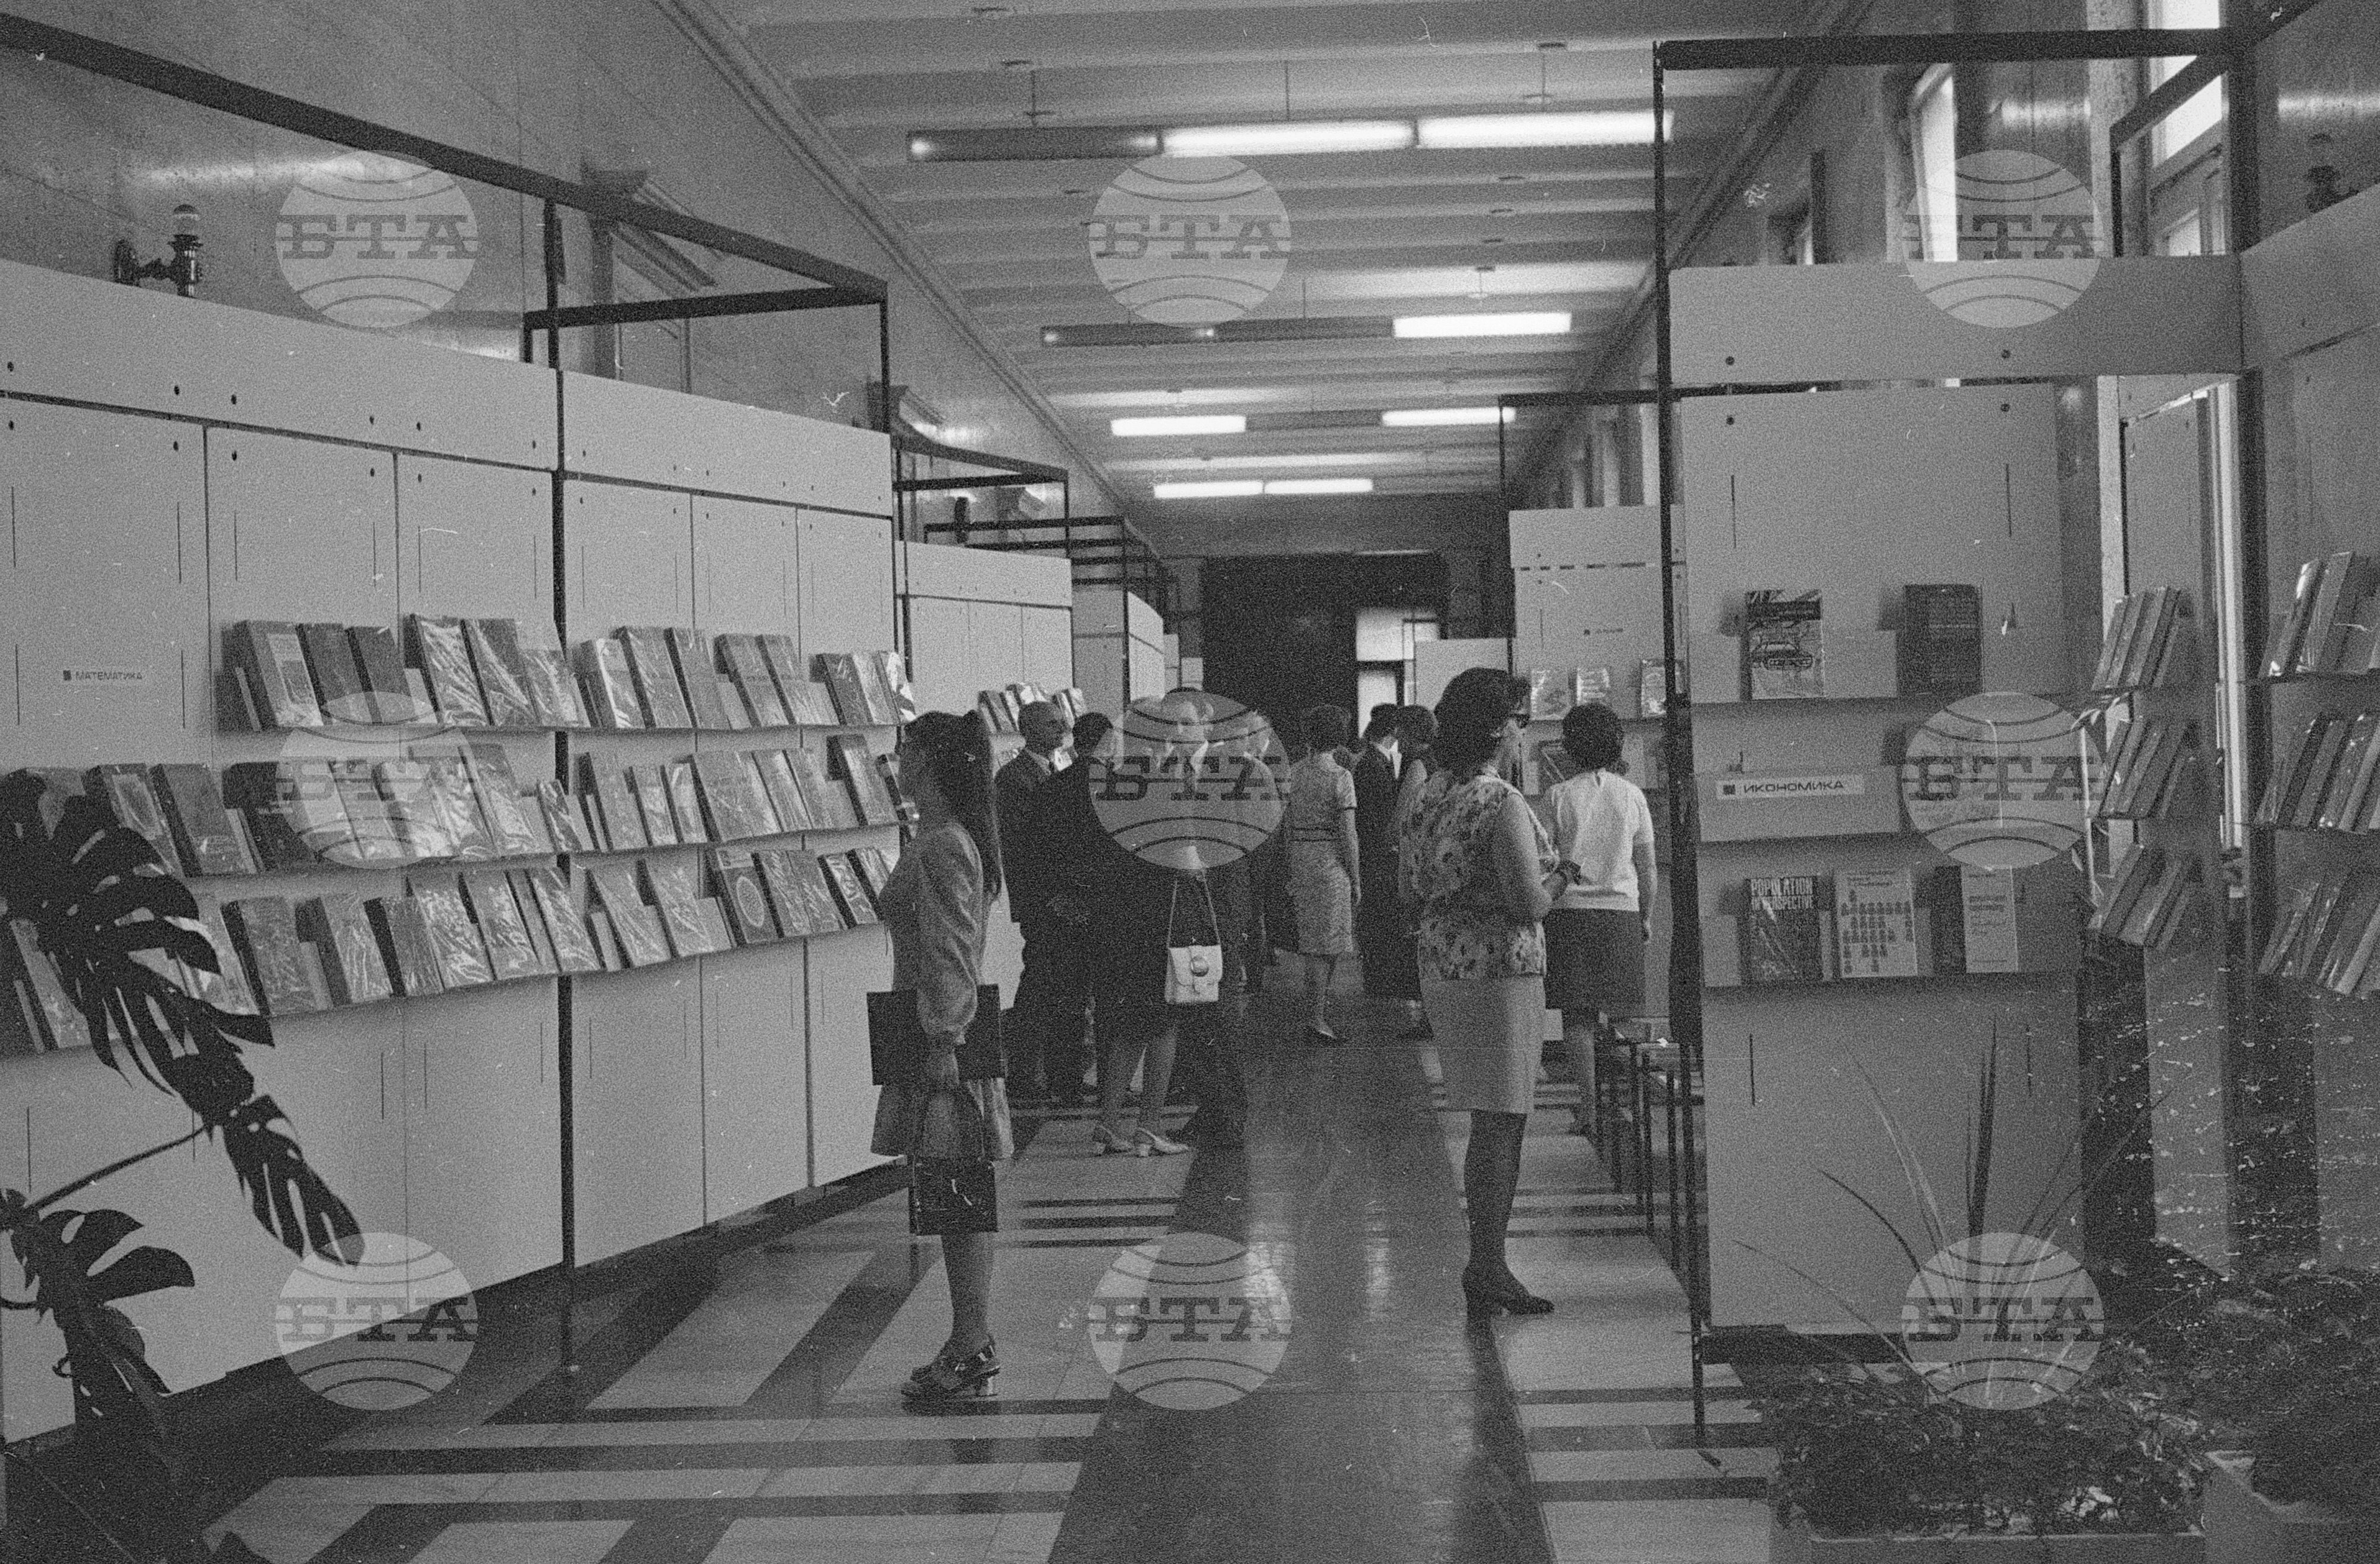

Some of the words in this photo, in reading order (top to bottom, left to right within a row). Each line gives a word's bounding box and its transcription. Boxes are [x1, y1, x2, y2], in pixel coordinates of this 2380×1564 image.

[75, 670, 143, 680] МАТЕМАТИКА
[1743, 780, 1844, 793] ИКОНОМИКА
[1750, 878, 1813, 896] POPULATION
